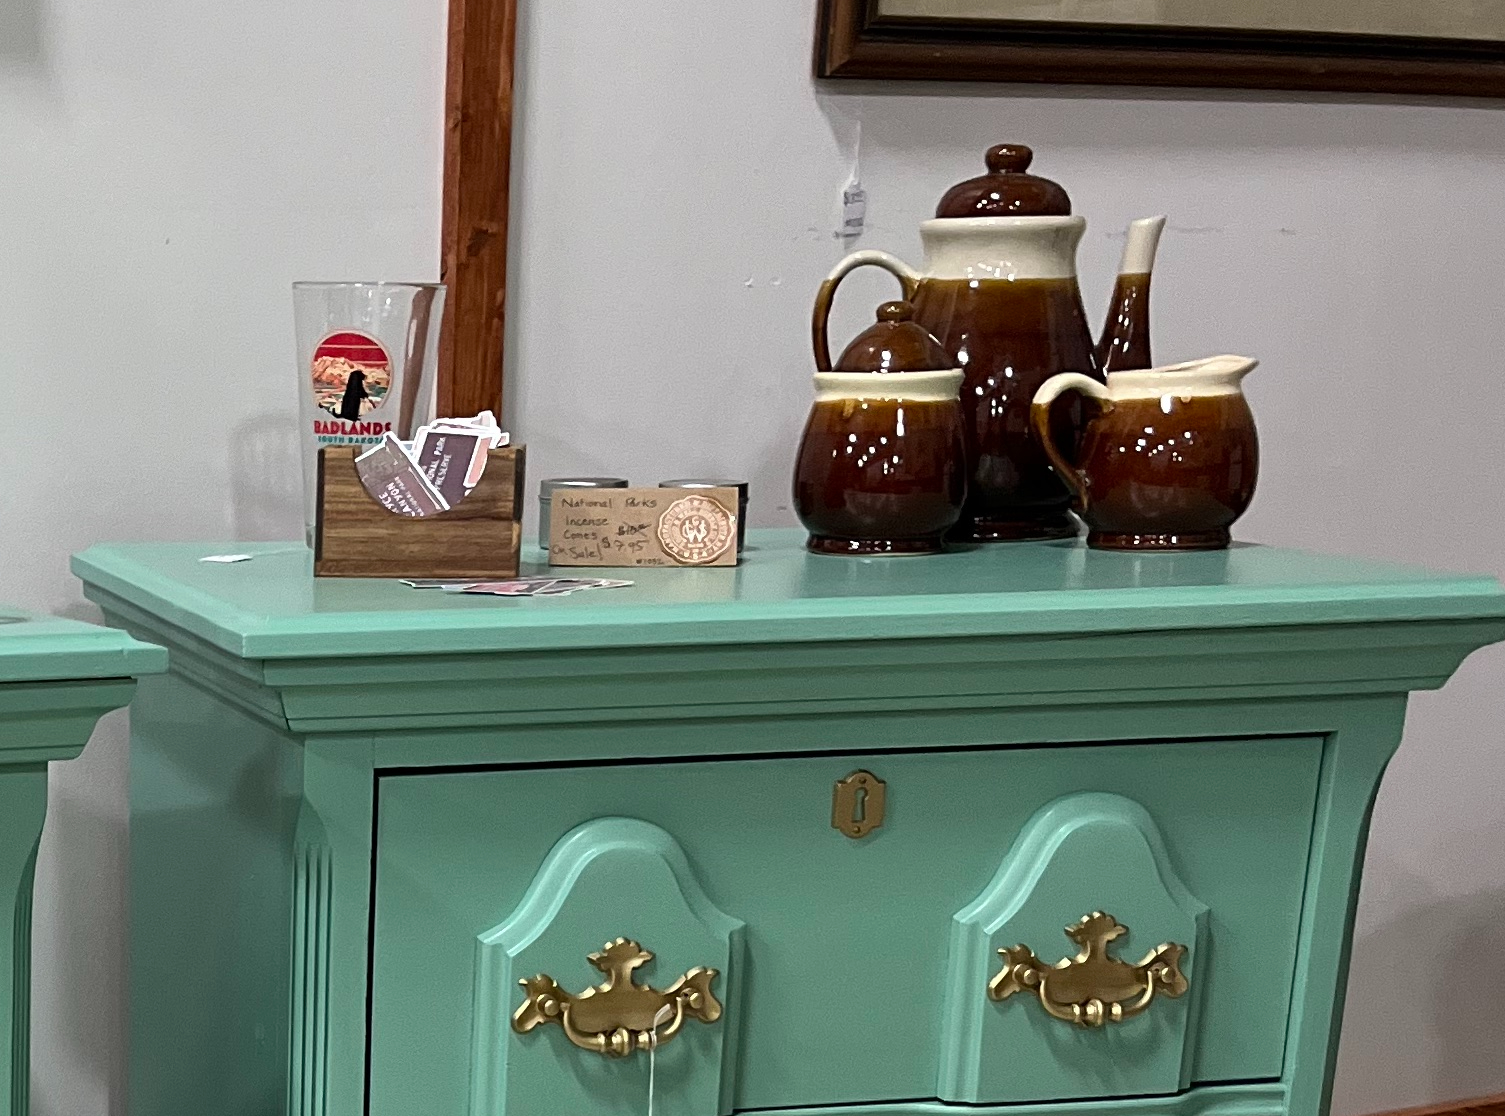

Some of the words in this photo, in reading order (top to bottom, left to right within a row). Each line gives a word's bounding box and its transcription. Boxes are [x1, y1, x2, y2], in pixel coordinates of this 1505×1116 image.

[314, 420, 392, 436] BADLANDS
[318, 435, 345, 443] SOUTH
[348, 436, 384, 444] DAKOT
[561, 498, 613, 509] National
[625, 497, 658, 509] Parks
[565, 515, 609, 527] Incense
[563, 529, 598, 540] Cones
